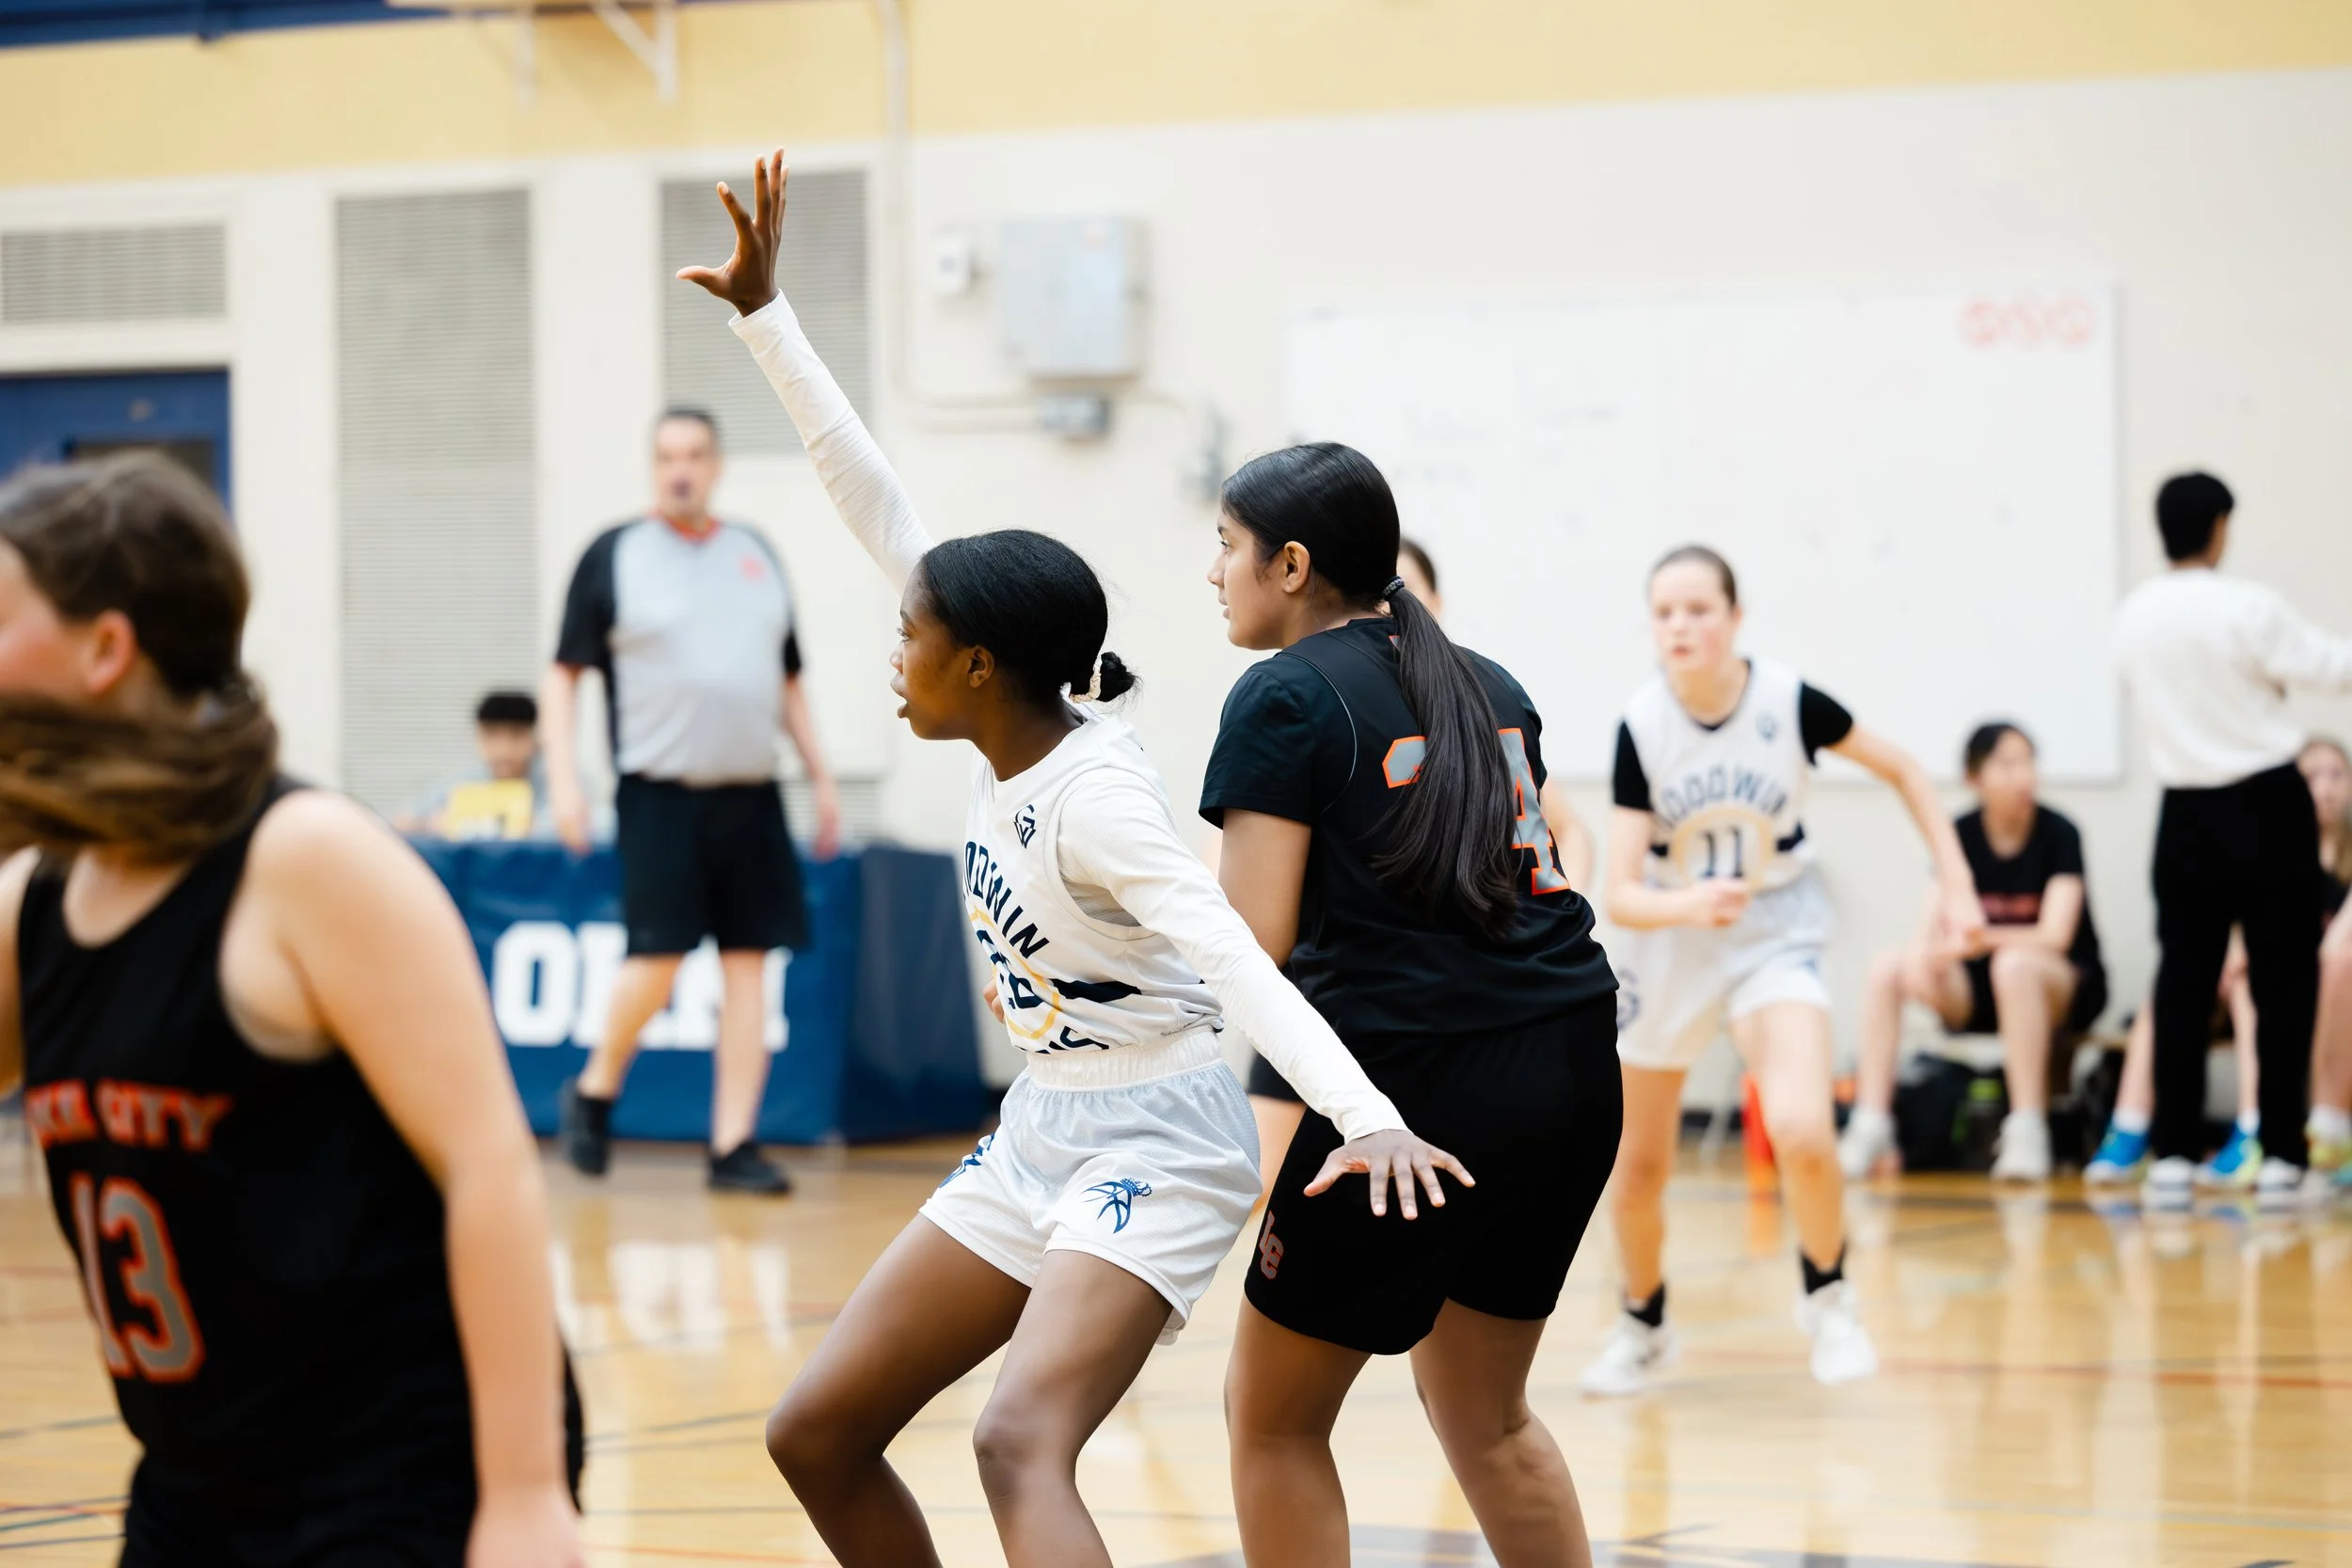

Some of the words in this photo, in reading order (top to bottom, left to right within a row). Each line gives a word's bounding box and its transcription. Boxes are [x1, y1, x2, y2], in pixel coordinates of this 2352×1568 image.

[1697, 824, 1746, 879] 11
[96, 1077, 234, 1151] CITY
[70, 1171, 206, 1383] 13
